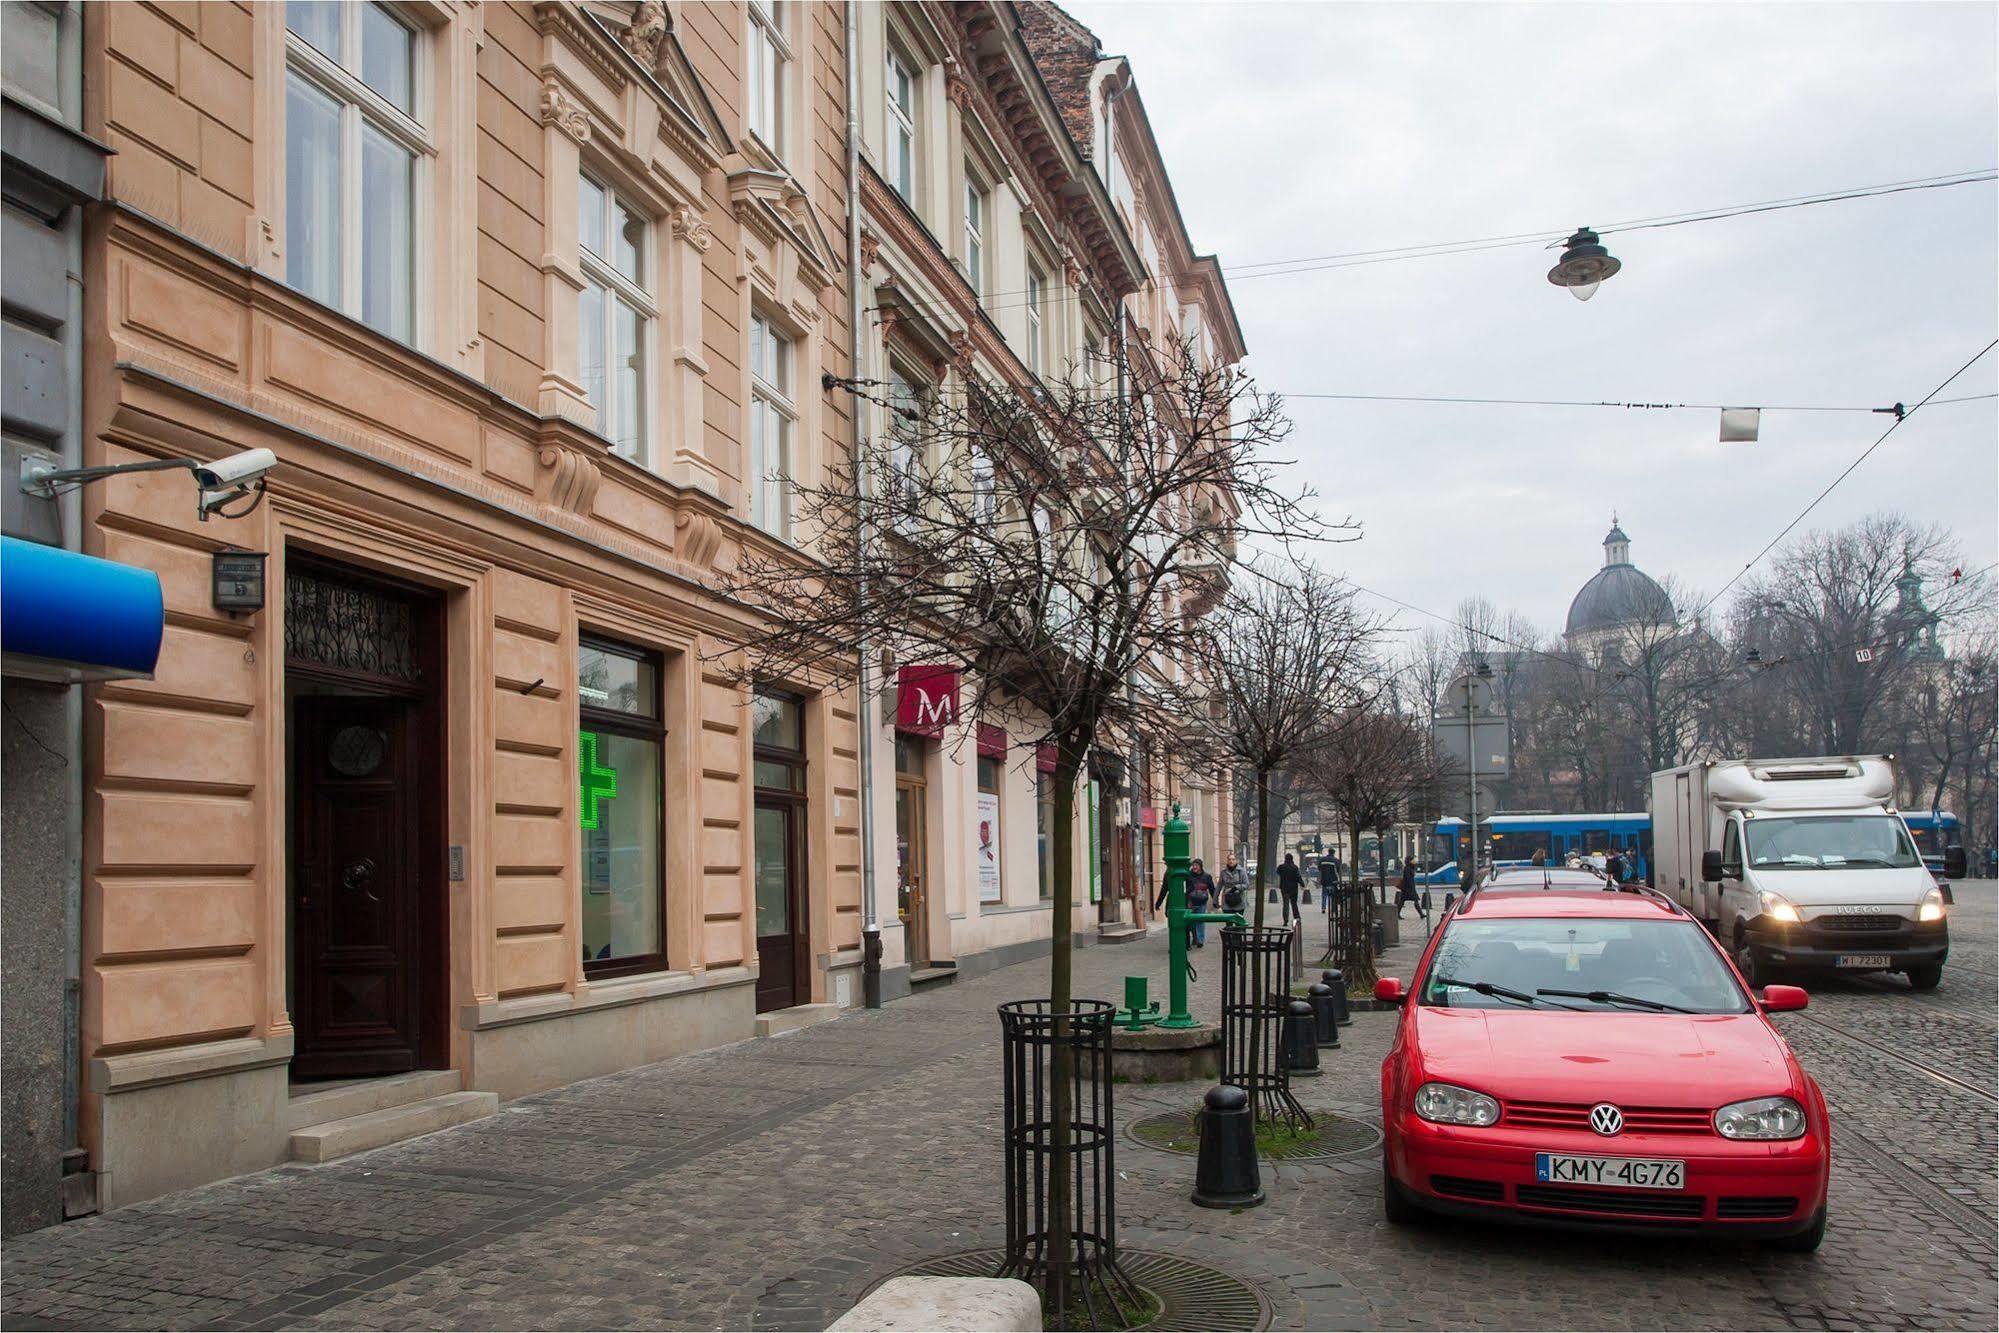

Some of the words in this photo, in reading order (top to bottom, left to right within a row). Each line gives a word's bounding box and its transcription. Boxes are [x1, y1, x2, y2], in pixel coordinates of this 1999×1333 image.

[1857, 650, 1870, 661] 10
[916, 687, 953, 725] M
[1836, 905, 1882, 914] IVECO
[1538, 1169, 1548, 1177] PL
